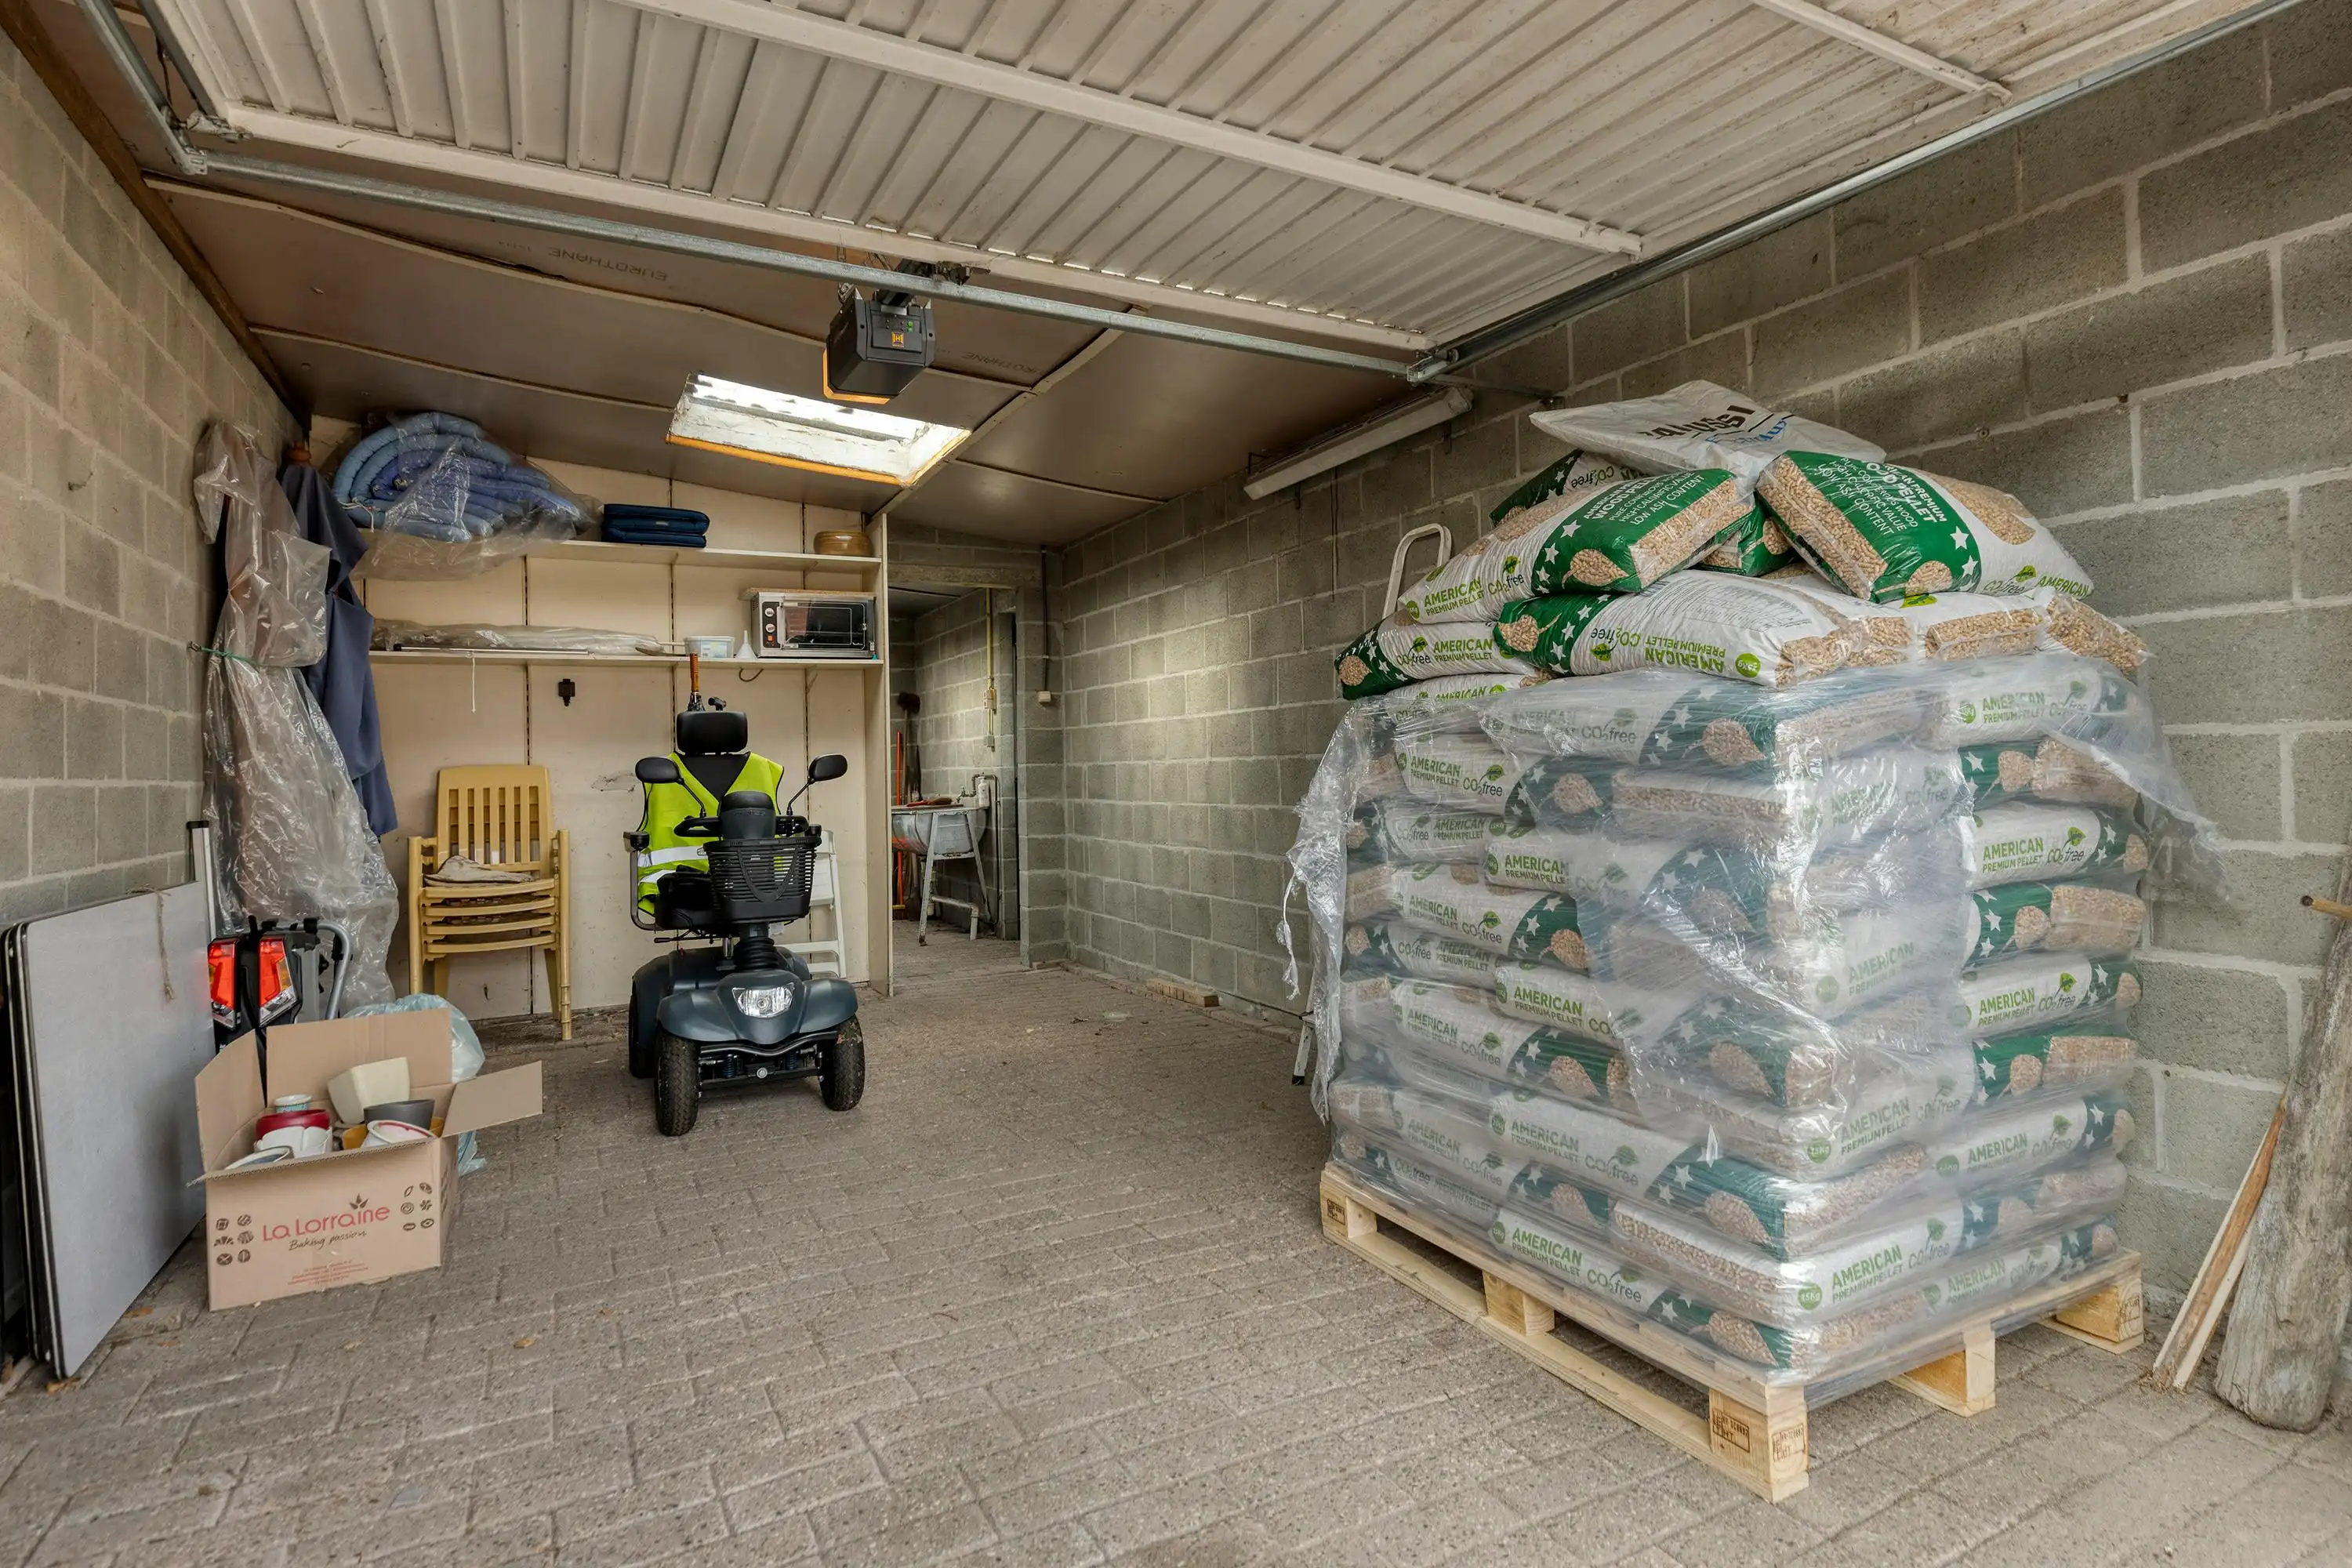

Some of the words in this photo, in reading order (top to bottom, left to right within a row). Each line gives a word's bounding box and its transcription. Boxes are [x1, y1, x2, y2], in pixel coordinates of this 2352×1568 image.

[1631, 510, 1651, 524] LOW
[1650, 499, 1668, 513] ASH
[1666, 474, 1704, 501] CONTENT
[1854, 498, 1894, 535] CONTENT
[1883, 506, 1907, 532] VALUE
[1424, 577, 1482, 607] AMERICAN
[1426, 601, 1458, 616] PREMIUM
[1433, 639, 1493, 653] AMERICAN
[1646, 636, 1679, 649] PELLET
[1680, 638, 1726, 658] PREMIUM
[1645, 647, 1725, 673] AMERICAN
[1410, 756, 1461, 777] AMERICAN
[1434, 818, 1486, 830] AMERICAN
[1983, 837, 2044, 861] AMERICAN
[1504, 855, 1565, 875] AMERICA
[1505, 869, 1539, 882] PREMIUM
[1982, 858, 2017, 873] PREMIUM
[2017, 855, 2043, 867] PELLET
[1409, 895, 1457, 920] AMERICAN
[1849, 942, 1915, 983] AMERICAN
[1514, 985, 1582, 1017] AMERICAN
[1514, 1000, 1551, 1018] PREMIUM
[1980, 987, 2035, 1015] AMERICAN
[1408, 1009, 1458, 1040] AMERICAN
[1977, 1012, 2011, 1027] PREMIUM
[1842, 1096, 1911, 1143] AMERICAN
[1512, 1120, 1580, 1153] AMERICAN
[1968, 1132, 2028, 1164] AMERICAN
[263, 1225, 291, 1242] La
[296, 1206, 390, 1236] Lorraine
[289, 1237, 325, 1251] Baking
[328, 1230, 367, 1247] passion
[1512, 1227, 1583, 1265] AMERICAN
[1512, 1242, 1548, 1264] PREMIUM
[1549, 1258, 1581, 1277] PELLET
[1832, 1245, 1903, 1290] AMERICAN
[1947, 1258, 2005, 1294] AMERICAN
